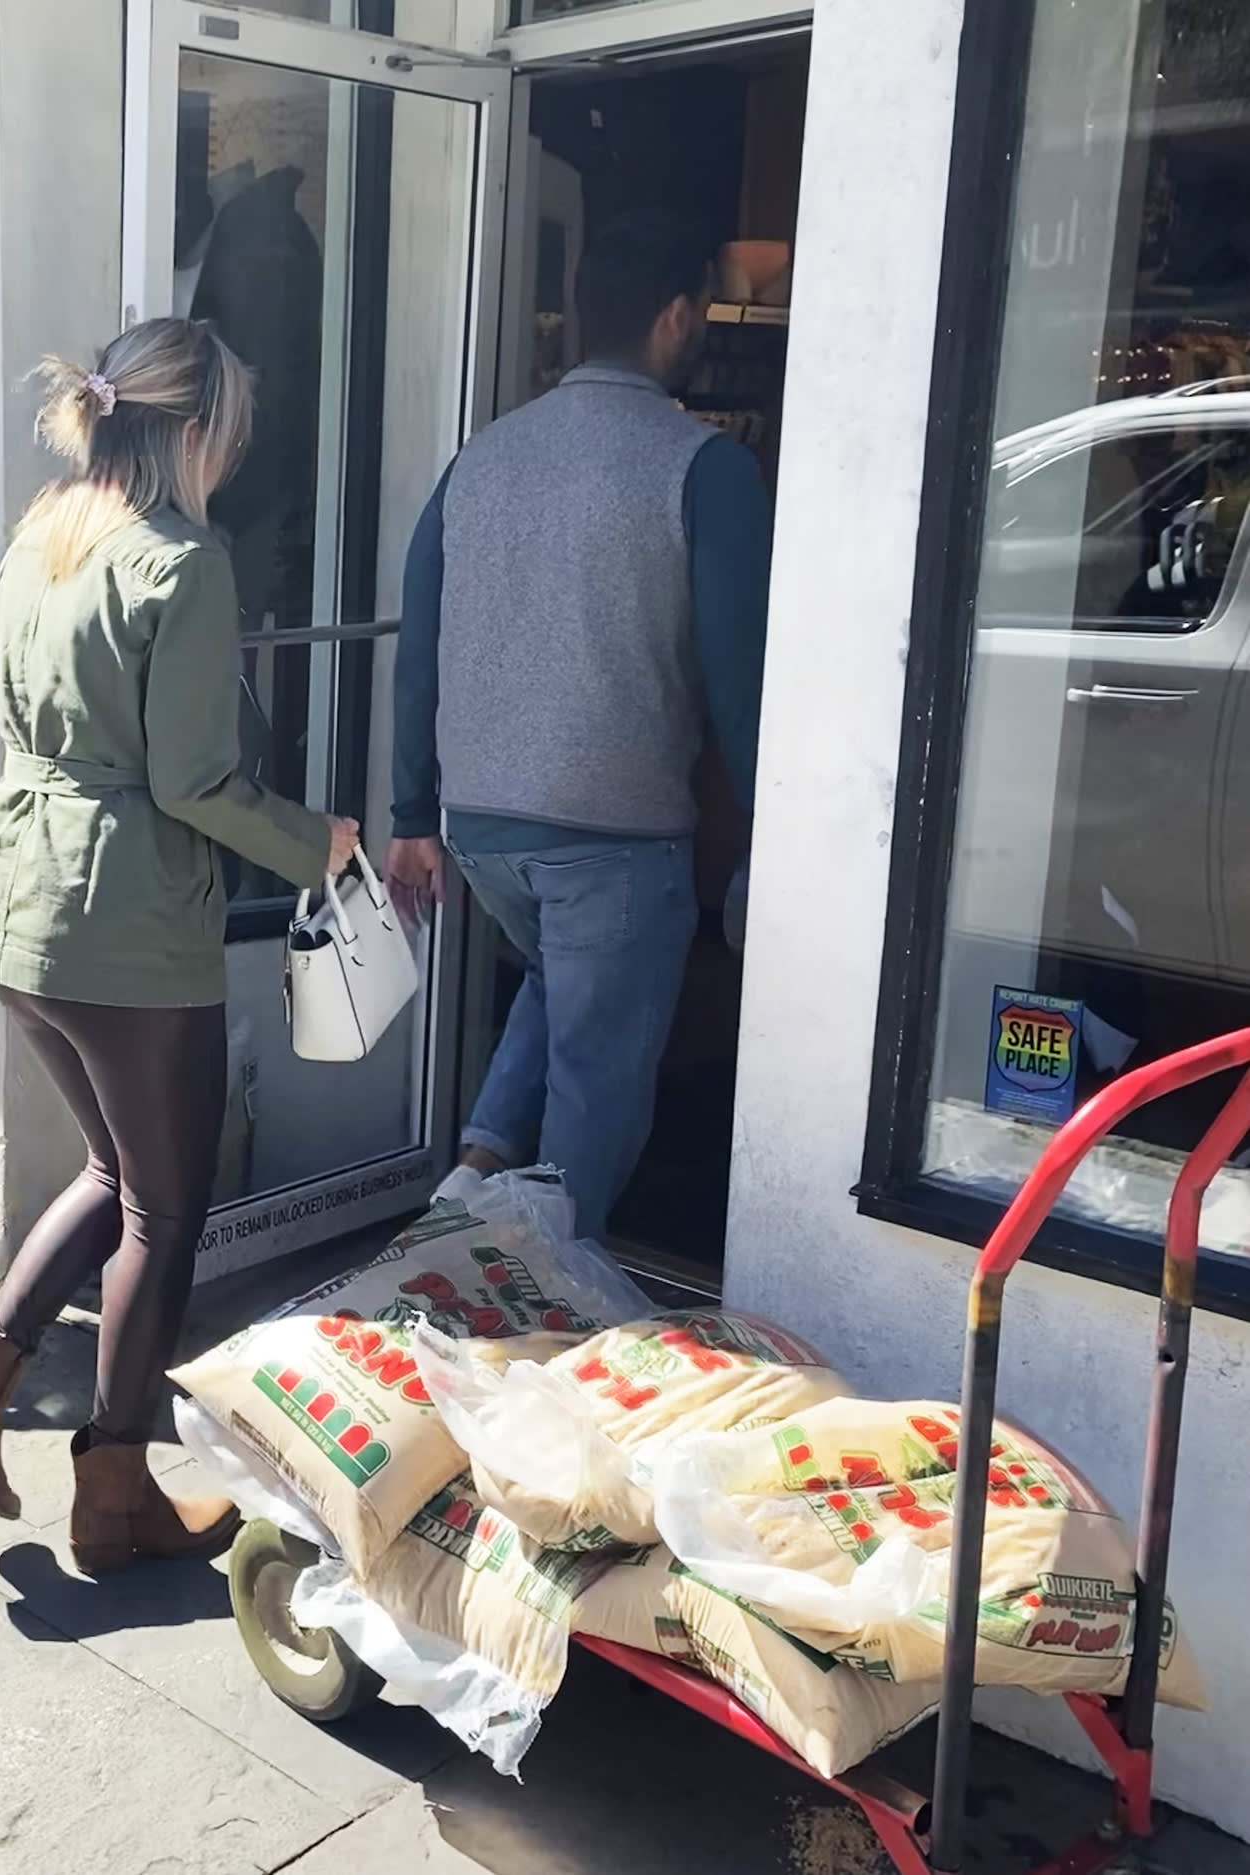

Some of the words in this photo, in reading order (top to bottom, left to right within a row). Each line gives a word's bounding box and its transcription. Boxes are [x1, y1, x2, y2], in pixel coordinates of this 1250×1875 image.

[1008, 1021, 1063, 1055] SAFE
[1005, 1049, 1059, 1078] PLACE
[196, 1230, 218, 1253] OOR
[220, 1224, 233, 1245] TO
[235, 1213, 271, 1240] REMAIN
[272, 1196, 323, 1228] UNLOCKED
[325, 1183, 359, 1210] DURING
[1040, 1574, 1114, 1600] QUIKRETE
